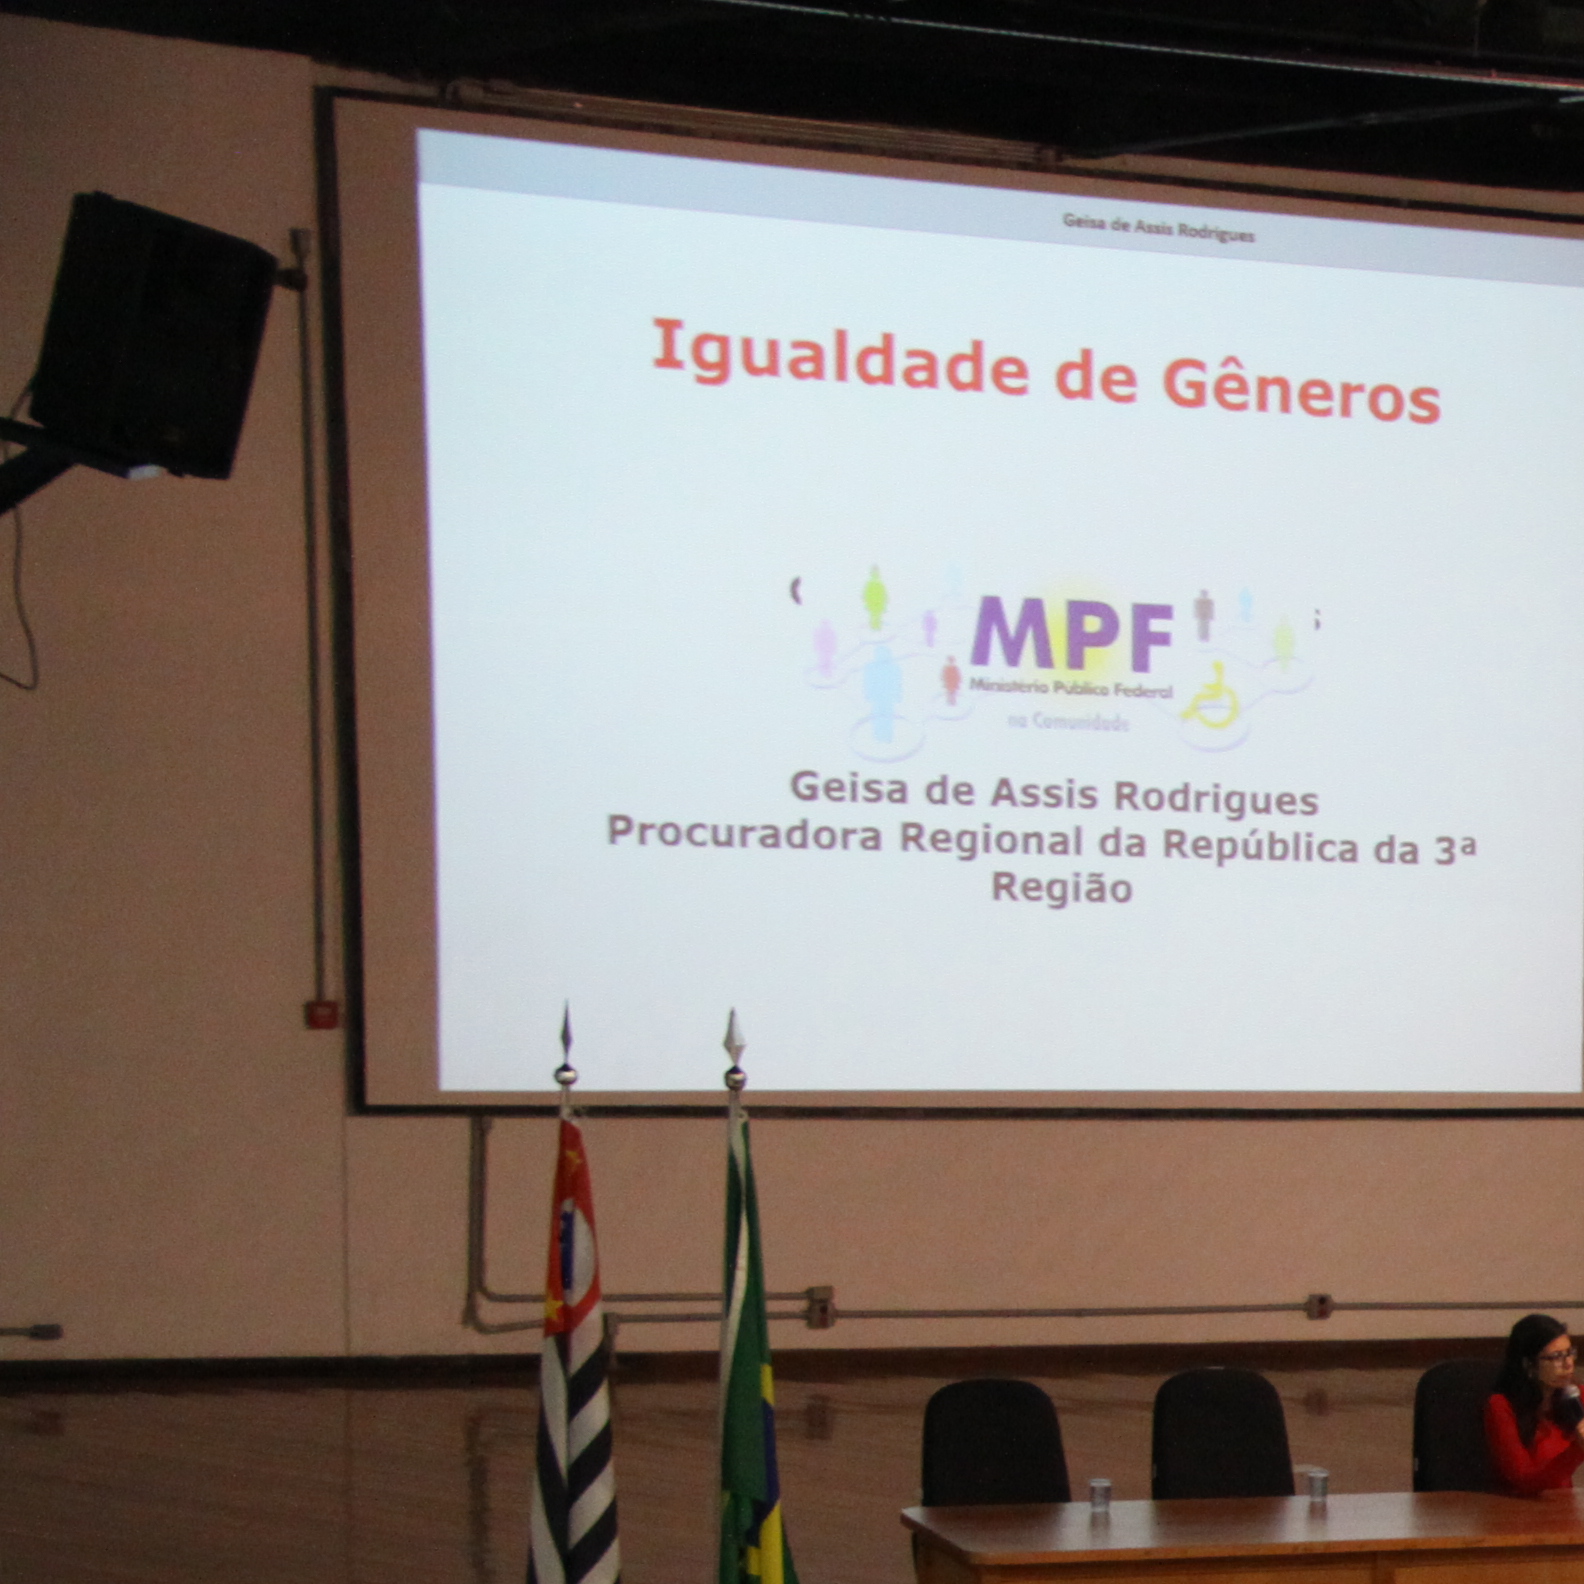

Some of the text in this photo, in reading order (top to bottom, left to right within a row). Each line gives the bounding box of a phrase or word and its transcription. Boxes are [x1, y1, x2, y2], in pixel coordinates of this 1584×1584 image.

[1063, 212, 1256, 245] Geisa de Assis Rodrigues
[653, 317, 1441, 425] Igualdade de Gêneros
[970, 595, 1174, 674] MPF
[969, 676, 1174, 699] Ministério Público Federal
[790, 769, 1319, 823] Geisa de Assis Rodrigues
[608, 813, 1477, 868] Procuradora Regional da República da 3ª
[992, 871, 1133, 911] Região
